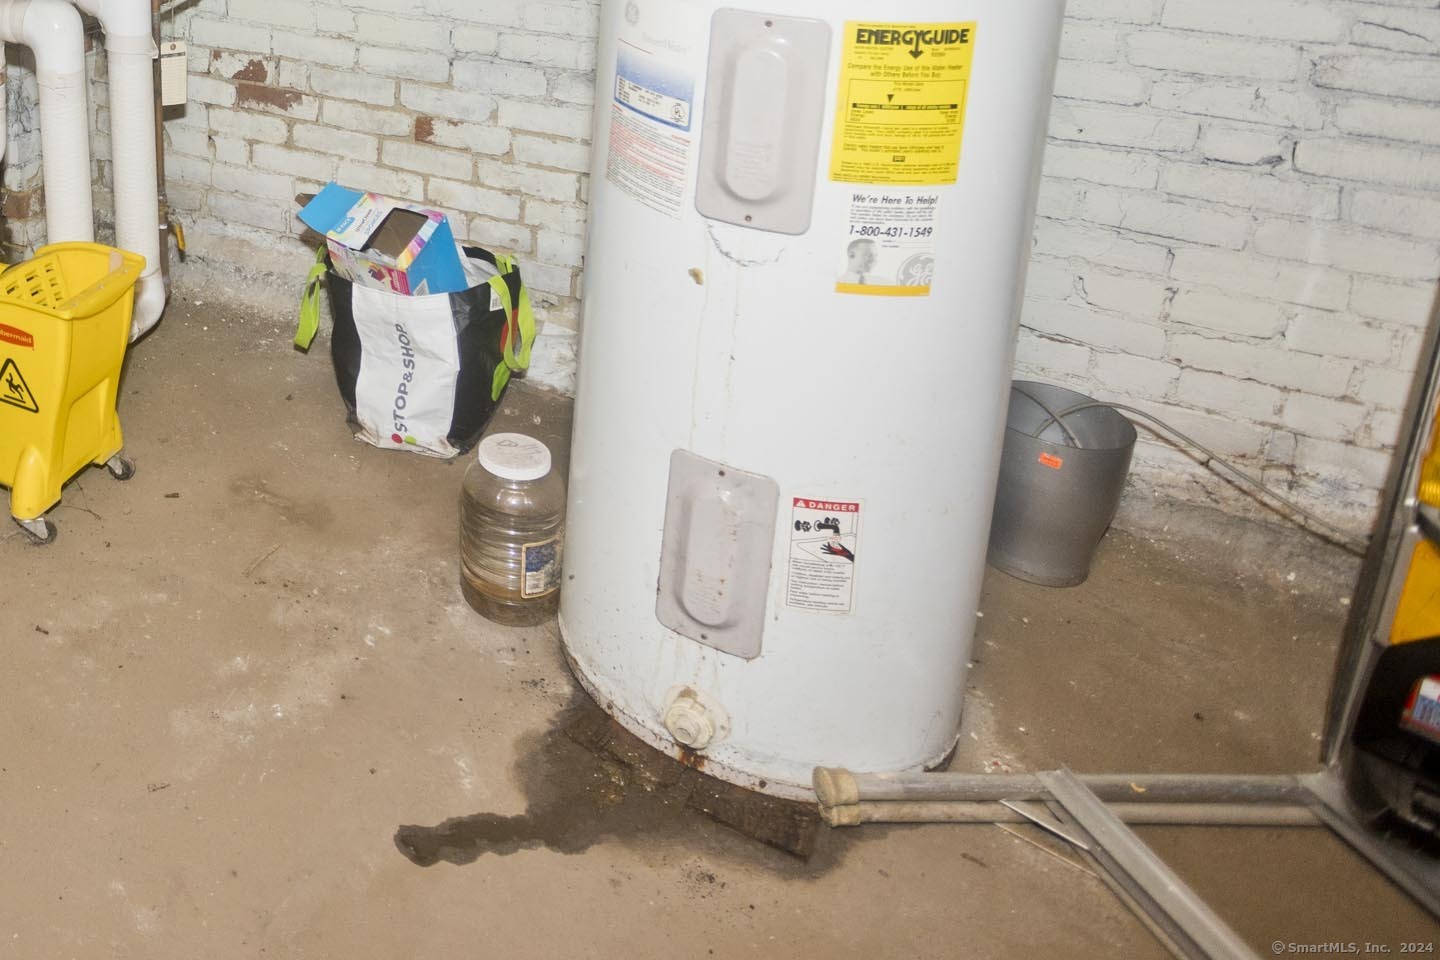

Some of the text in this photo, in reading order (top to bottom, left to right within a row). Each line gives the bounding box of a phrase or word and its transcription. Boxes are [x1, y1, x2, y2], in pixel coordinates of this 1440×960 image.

[855, 28, 970, 46] ENERGYGUIDE
[852, 194, 939, 206] We're Here To Help!
[849, 224, 934, 238] 1-800-431-1549
[808, 501, 857, 512] DANGER
